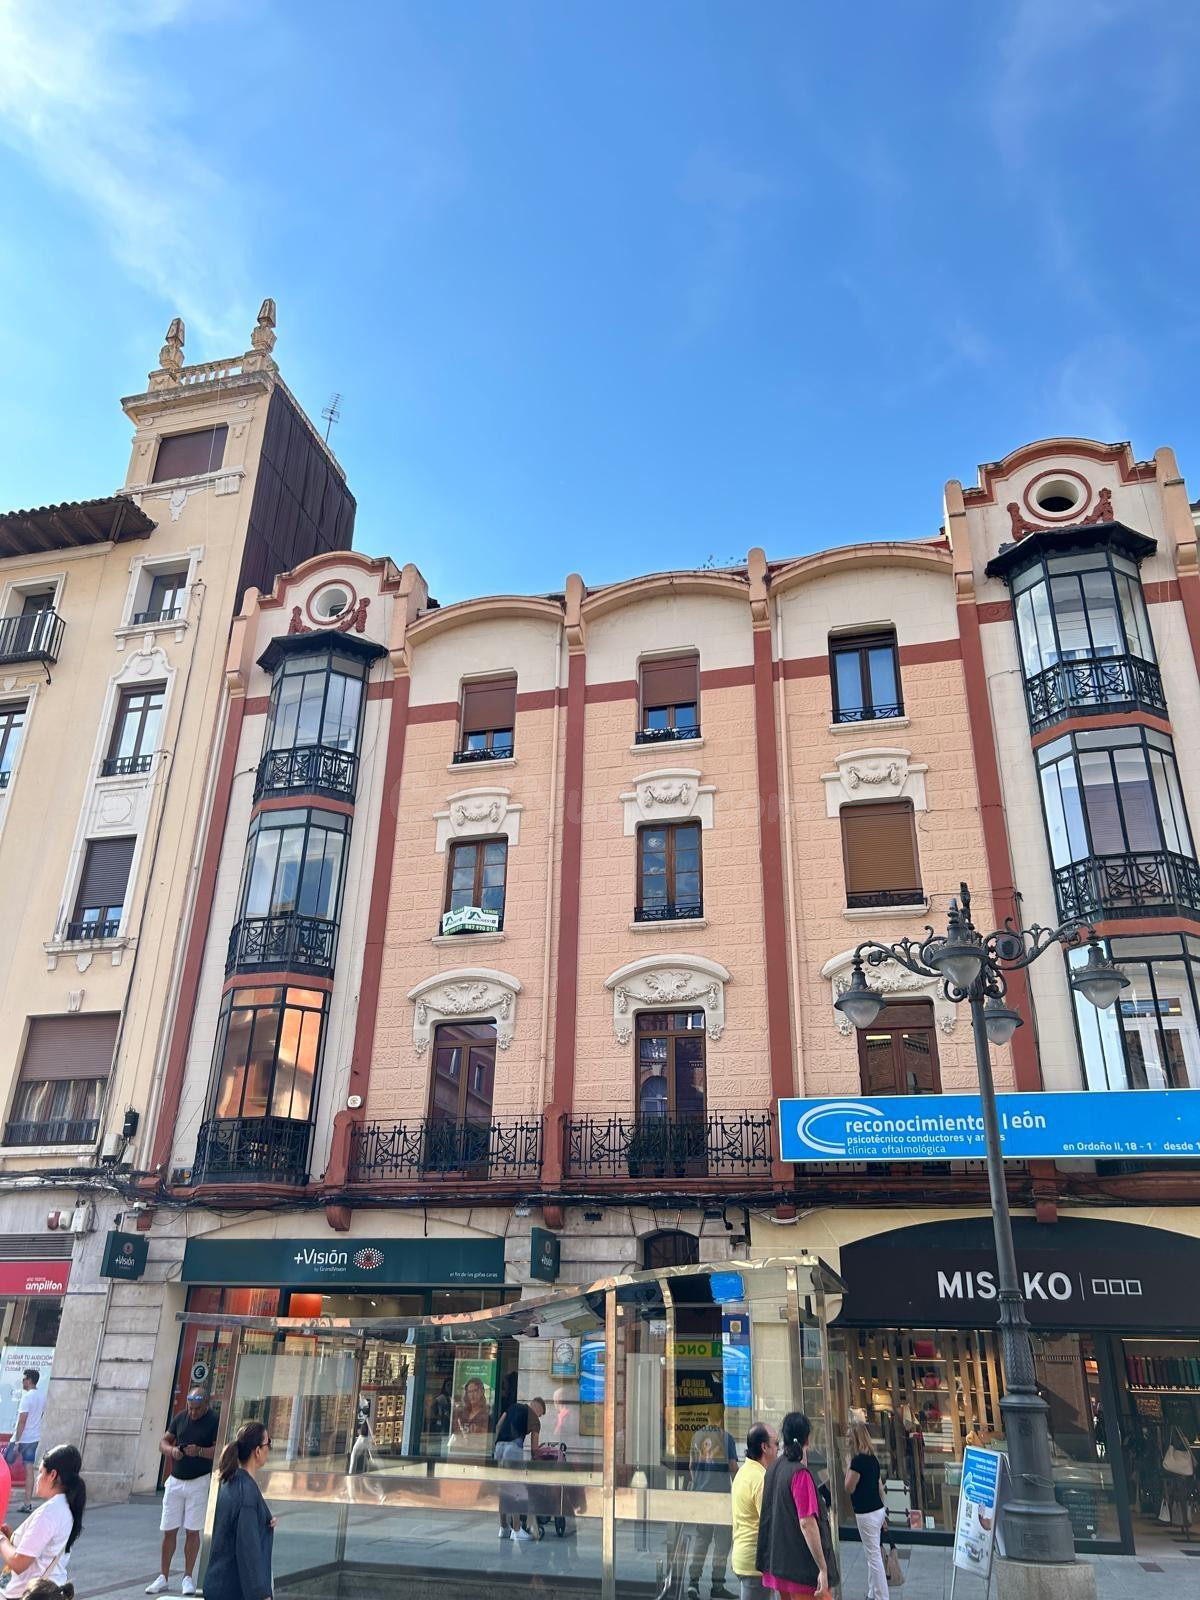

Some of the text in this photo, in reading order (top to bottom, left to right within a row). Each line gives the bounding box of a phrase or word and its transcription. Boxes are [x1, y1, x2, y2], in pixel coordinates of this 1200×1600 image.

[846, 1111, 1046, 1133] reconocimiento león
[847, 1133, 1006, 1146] psicotécnico conductores y ars
[848, 1144, 946, 1156] clínica oftalmológica
[1063, 1143, 1074, 1151] en
[1077, 1141, 1112, 1151] Ordoño
[1125, 1142, 1137, 1151] 18
[1163, 1142, 1194, 1151] desde
[26, 1280, 62, 1292] amplifon
[937, 1271, 1072, 1301] MISKO
